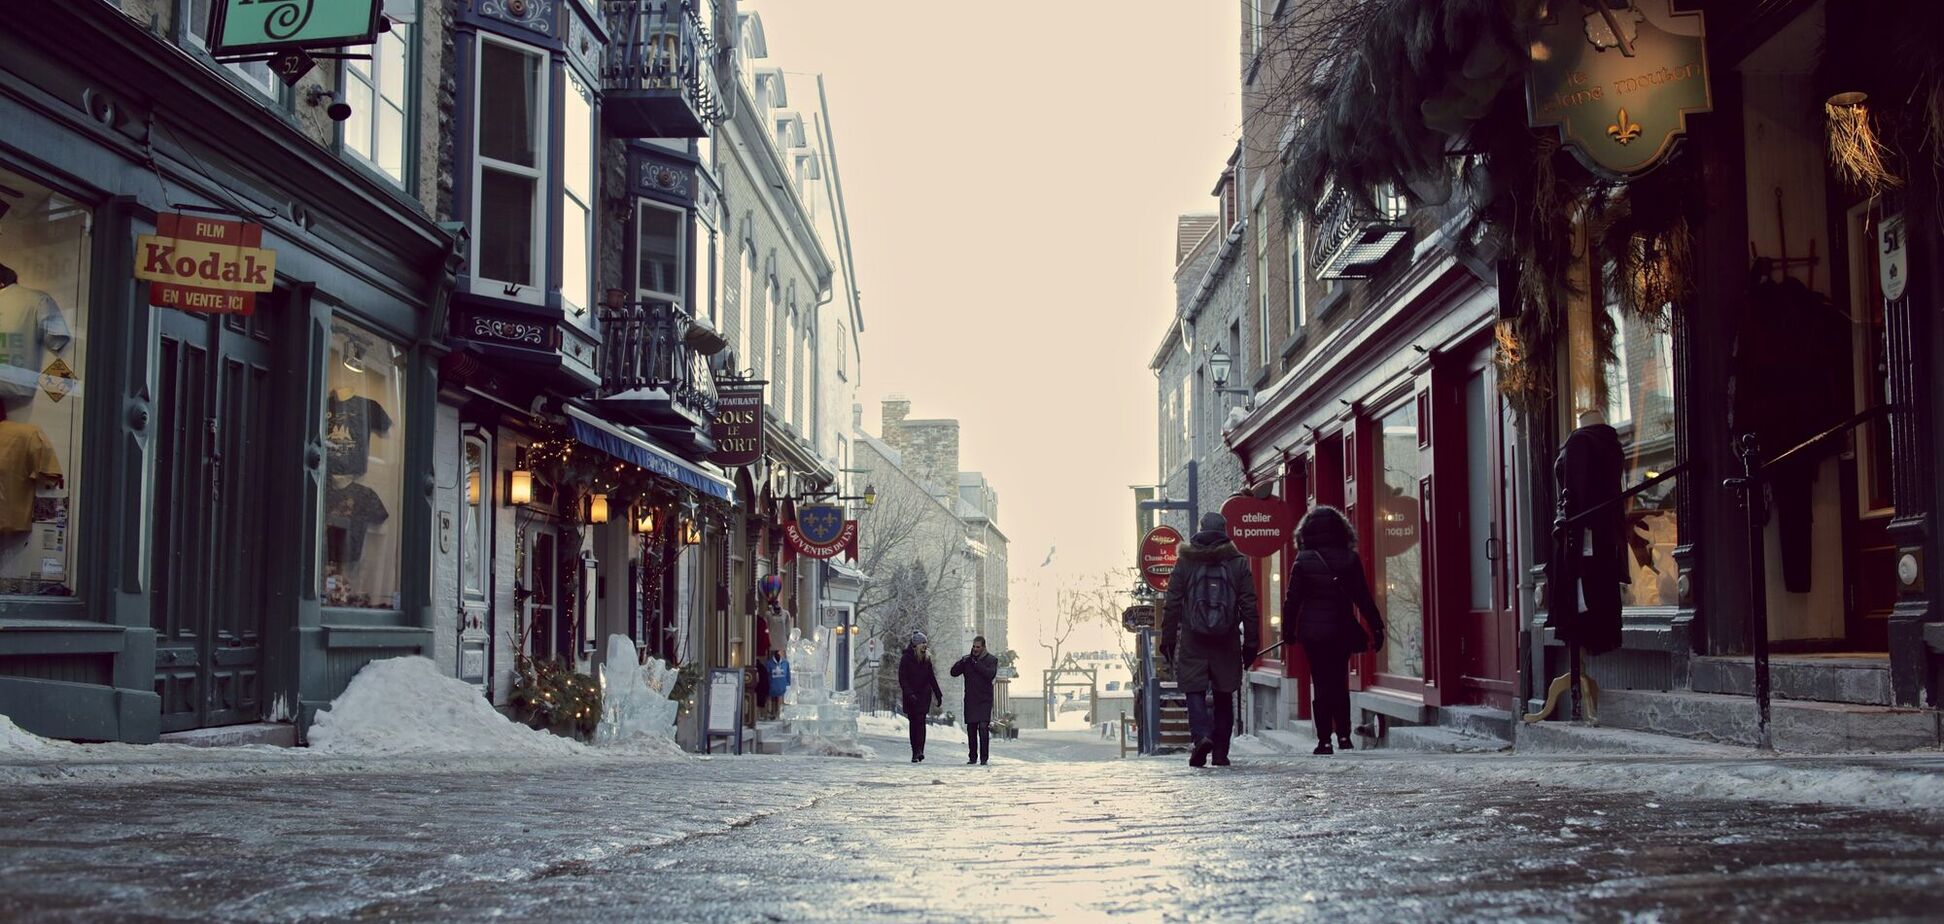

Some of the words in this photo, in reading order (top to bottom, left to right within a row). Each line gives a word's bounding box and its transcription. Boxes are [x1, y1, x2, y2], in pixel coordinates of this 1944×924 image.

[282, 56, 299, 74] 52
[196, 222, 225, 238] FILM
[1884, 228, 1900, 254] 51
[143, 243, 267, 285] Kodak
[163, 289, 179, 304] EN
[185, 292, 223, 309] VENTE
[228, 295, 243, 310] ICI
[718, 397, 759, 406] STAURANT
[713, 410, 754, 425] SOUS
[727, 426, 740, 436] LE
[442, 517, 450, 530] 50
[1242, 513, 1272, 523] atelier
[1233, 526, 1243, 537] la
[1244, 528, 1281, 538] pomme
[787, 525, 834, 556] SOUVENIRS
[833, 540, 845, 552] DU
[842, 524, 854, 542] LYS
